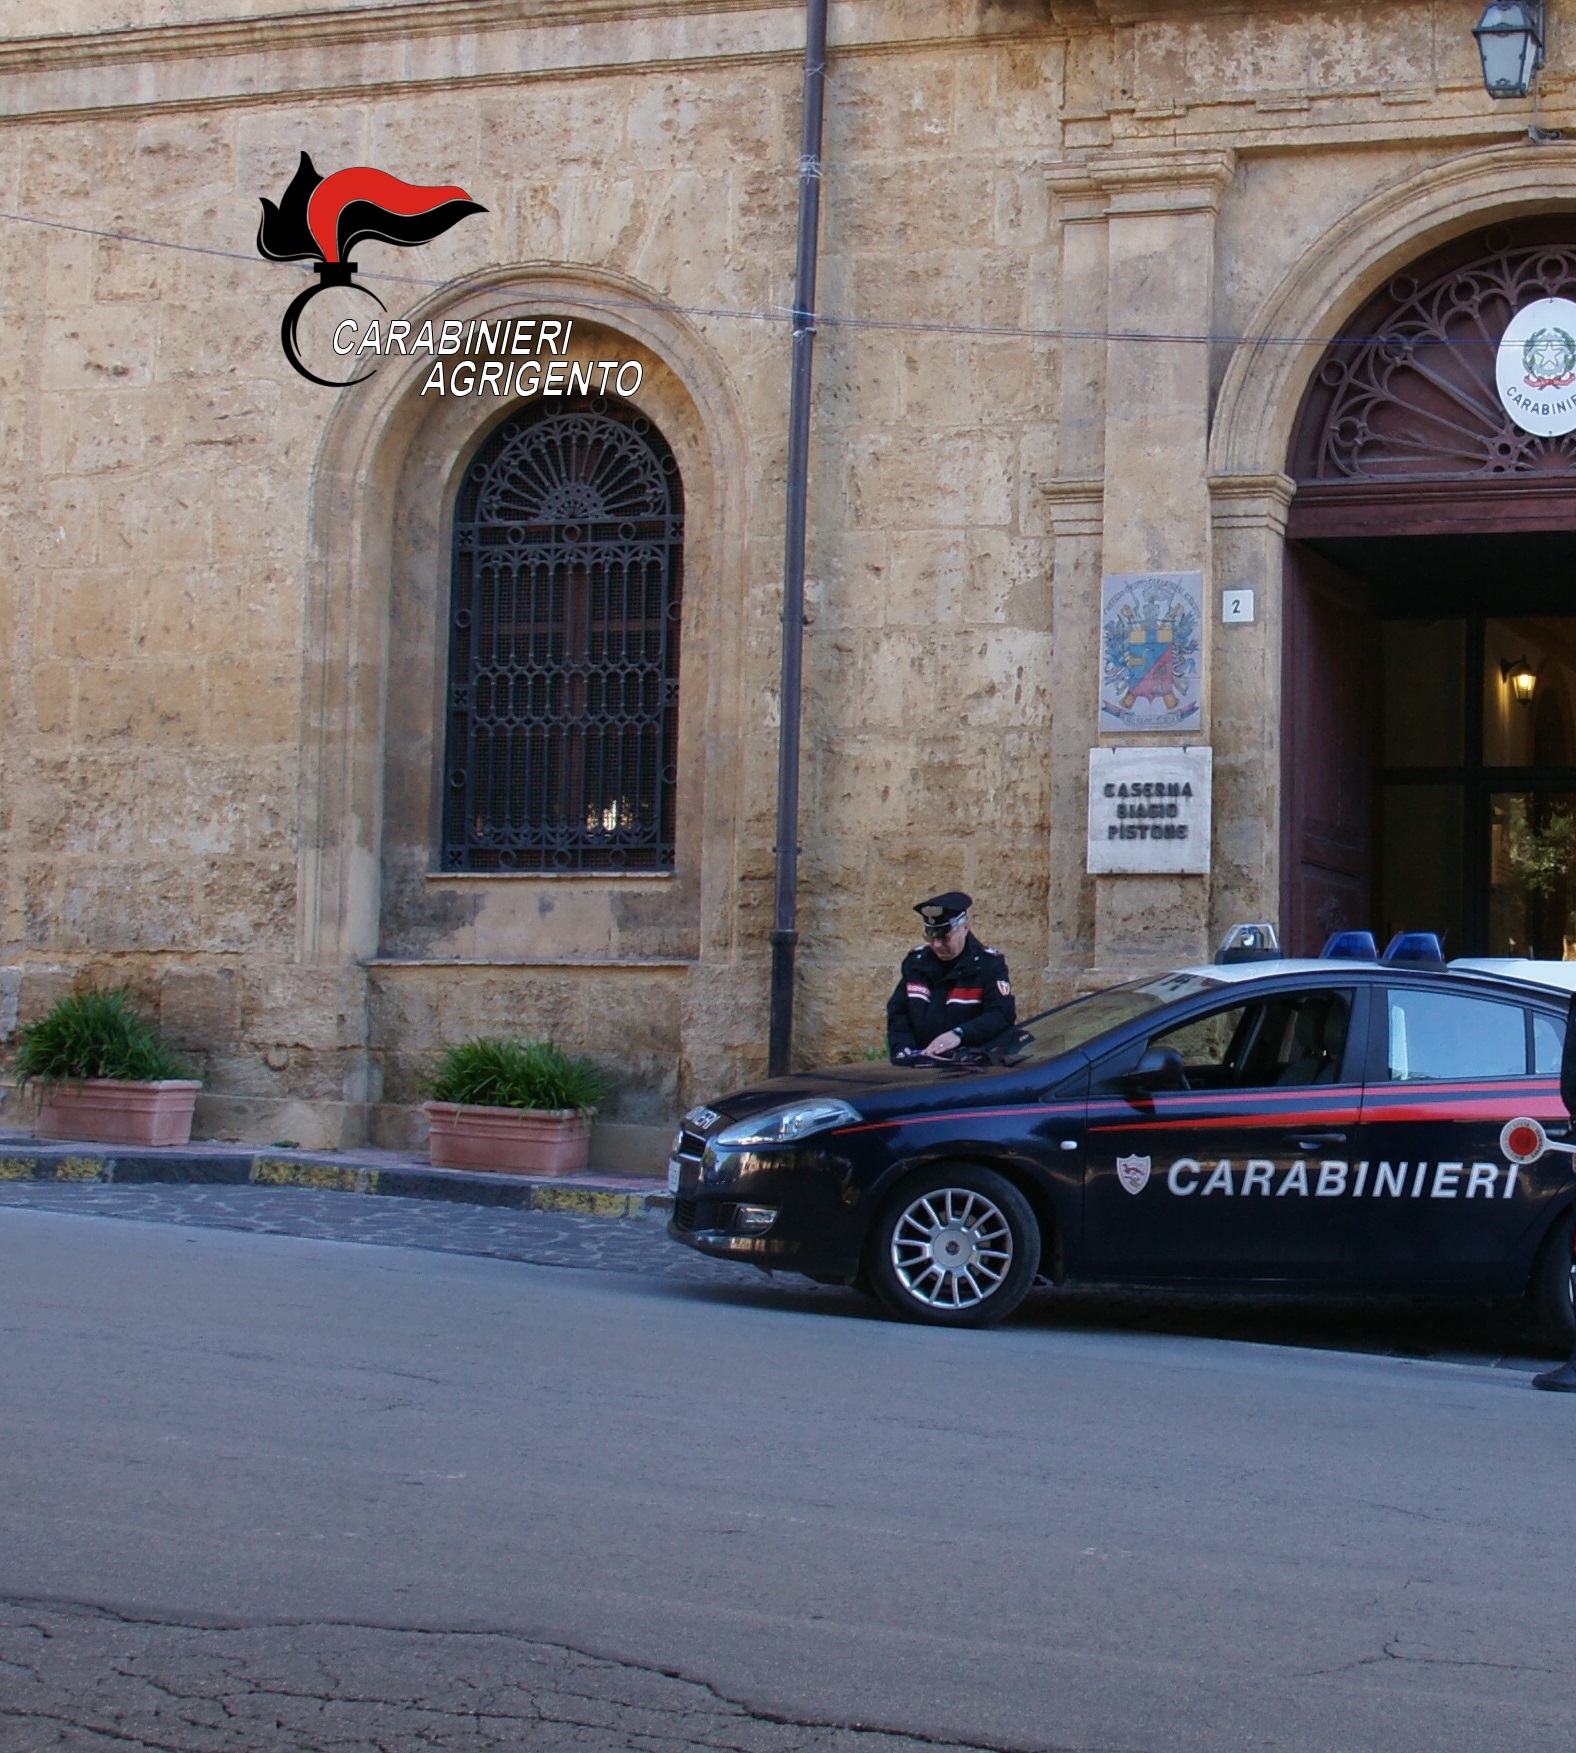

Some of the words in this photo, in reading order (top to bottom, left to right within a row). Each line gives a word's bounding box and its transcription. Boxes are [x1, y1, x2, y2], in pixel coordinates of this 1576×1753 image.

[1232, 599, 1241, 614] 2
[1104, 782, 1193, 797] CASERMA
[1117, 803, 1178, 818] BIAGIO
[1108, 823, 1189, 840] PISTONE
[1167, 1157, 1519, 1199] CARABINIERI
